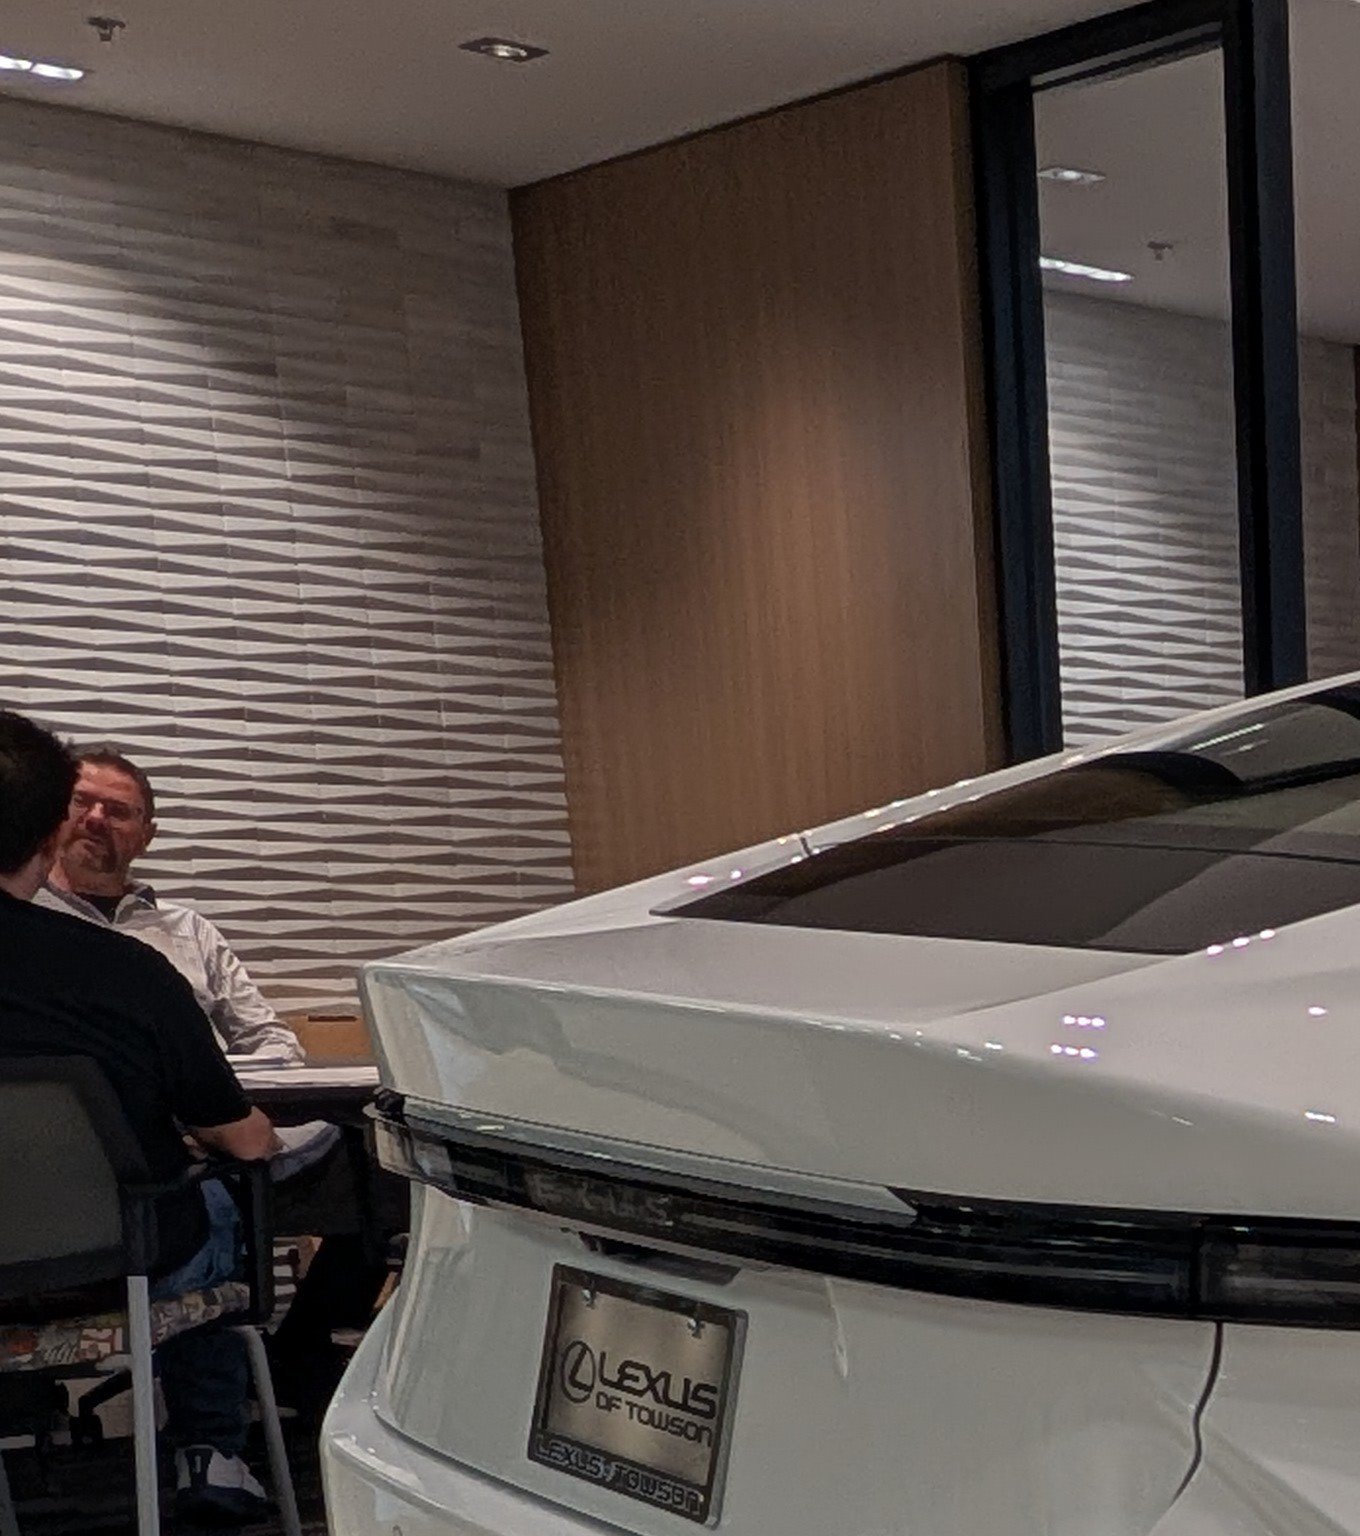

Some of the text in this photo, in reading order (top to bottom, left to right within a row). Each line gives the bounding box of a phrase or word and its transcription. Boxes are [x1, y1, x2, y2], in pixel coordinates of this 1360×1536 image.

[595, 1391, 623, 1414] OF
[599, 1351, 717, 1420] LEXUS
[533, 1433, 602, 1478] LEXUS
